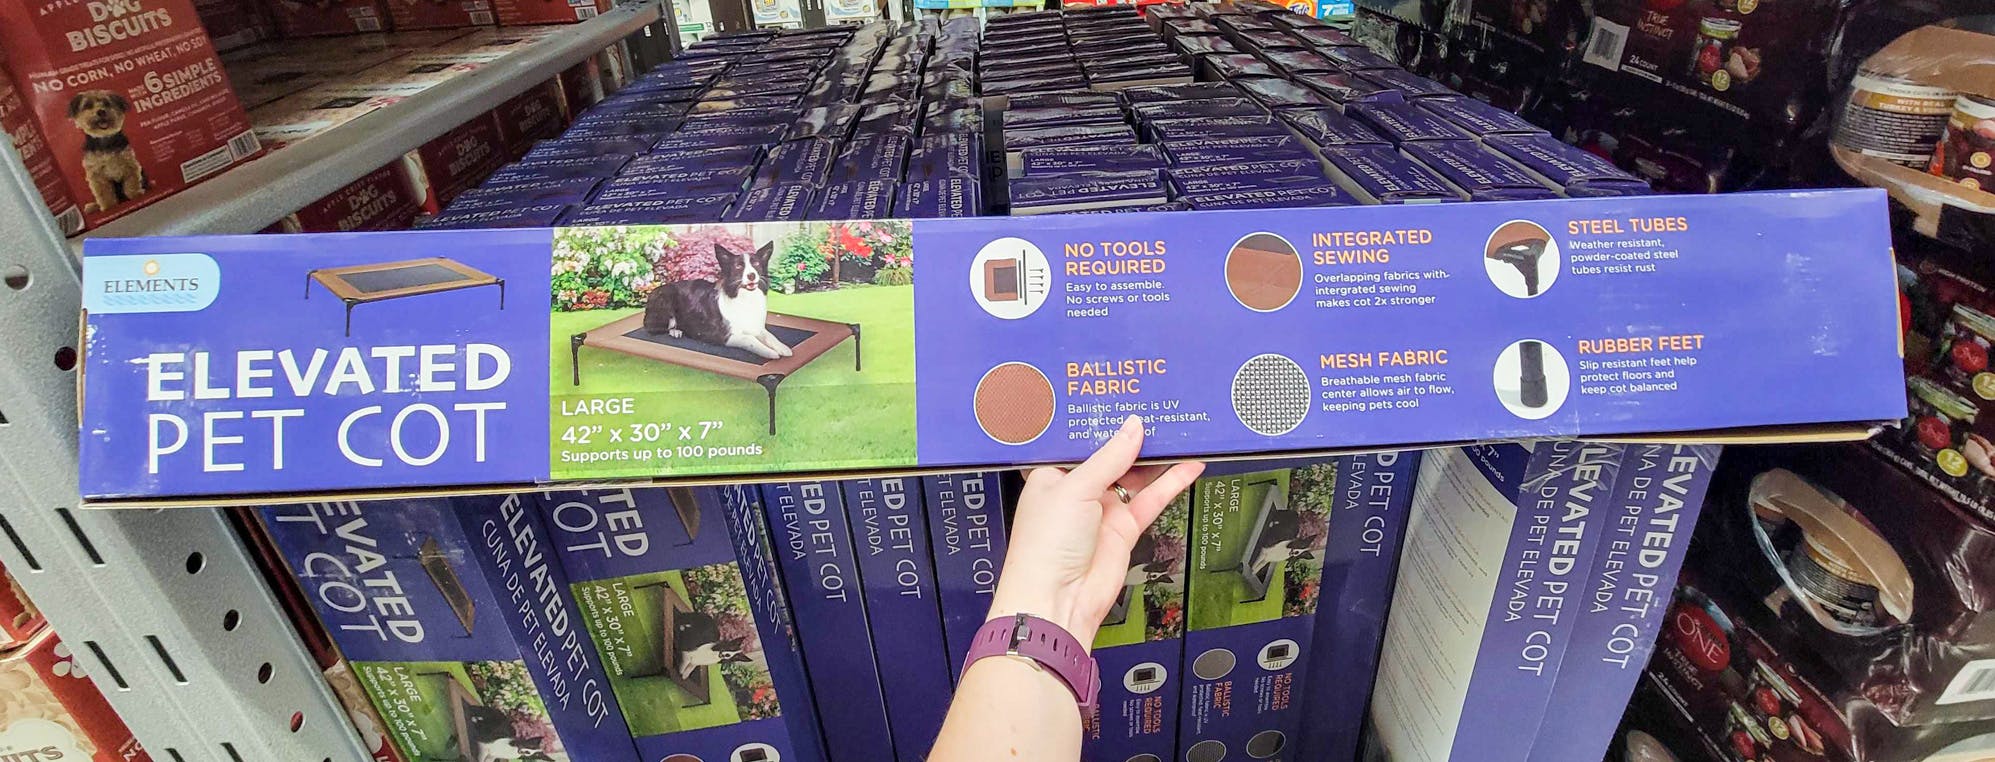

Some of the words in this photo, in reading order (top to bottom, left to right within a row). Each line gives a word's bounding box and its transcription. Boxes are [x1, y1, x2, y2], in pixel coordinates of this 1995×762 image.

[66, 8, 172, 52] BISCUITS
[32, 78, 64, 94] NO
[114, 59, 134, 73] NO
[175, 41, 191, 54] NO
[144, 71, 163, 93] 6
[162, 57, 216, 88] SIMPLE
[1630, 54, 1639, 65] 24
[133, 71, 221, 113] INGREDIENTS
[584, 200, 664, 211] ELEVATED
[1195, 191, 1276, 203] ELEVATED
[1312, 229, 1433, 247] INTEGRATED
[1568, 220, 1624, 234] STEEL
[1629, 217, 1688, 232] TUBES
[1065, 243, 1094, 258] NO
[1101, 241, 1166, 256] TOOLS
[1313, 249, 1390, 265] SEWING
[1569, 239, 1614, 250] Weather
[1617, 238, 1665, 248] resistant,
[1571, 252, 1651, 263] powder-coated
[1653, 250, 1679, 259] steel
[1066, 259, 1166, 277] REQUIRED
[1314, 272, 1381, 284] Overlapping
[1383, 271, 1420, 281] fabrics
[1423, 270, 1447, 279] with
[1572, 265, 1601, 275] tubes
[1604, 264, 1632, 273] resist
[1635, 263, 1656, 272] rust
[103, 277, 199, 294] ELEMENTS
[1066, 282, 1092, 293] Easy
[1095, 281, 1107, 291] to
[1110, 280, 1165, 290] assemble.
[1066, 295, 1083, 305] No
[1086, 295, 1124, 304] screws
[1127, 294, 1139, 302] or
[1142, 292, 1170, 302] tools
[1315, 285, 1376, 297] intergrated
[1379, 284, 1416, 294] sewing
[1067, 307, 1109, 317] needed
[1316, 298, 1351, 308] makes
[1353, 297, 1371, 306] cot
[1374, 296, 1388, 306] 2x
[1390, 295, 1436, 307] stronger
[1320, 353, 1372, 369] MESH
[1379, 350, 1449, 366] FABRIC
[1578, 338, 1653, 354] RUBBER
[1658, 335, 1704, 351] FEET
[147, 343, 511, 401] ELEVATED
[1067, 359, 1167, 378] BALLISTIC
[1321, 375, 1380, 386] Breathable
[1383, 374, 1412, 384] mesh
[1415, 372, 1446, 382] fabric
[1579, 360, 1599, 371] Slip
[1602, 358, 1646, 369] resistant
[1649, 357, 1671, 367] feet
[1674, 356, 1697, 367] help
[1580, 372, 1619, 383] protect
[1622, 370, 1652, 381] floors
[1655, 370, 1674, 379] and
[1067, 379, 1140, 396] FABRIC
[1322, 389, 1356, 399] center
[1360, 387, 1394, 397] allows
[1397, 387, 1411, 395] air
[1414, 386, 1426, 395] to
[1428, 384, 1455, 395] flow,
[1581, 385, 1606, 395] keep
[1609, 384, 1627, 393] cot
[1630, 382, 1677, 392] balanced
[561, 398, 635, 416] LARGE
[1068, 403, 1112, 414] Ballistic
[1115, 401, 1147, 412] fabric
[1151, 400, 1160, 410] is
[1163, 400, 1179, 410] UV
[1138, 412, 1210, 424] eat-resistant,
[1322, 401, 1366, 412] keeping
[1369, 401, 1393, 412] pets
[1396, 399, 1419, 409] cool
[148, 409, 305, 474] PET
[337, 402, 507, 467] COT
[609, 429, 622, 443] x
[678, 426, 691, 441] x
[1069, 429, 1090, 440] and
[1093, 426, 1156, 439] wateof
[561, 448, 630, 463] Supports
[633, 450, 652, 462] up
[656, 447, 673, 459] to
[676, 446, 703, 458] 100
[708, 443, 763, 459] pounds
[1229, 479, 1240, 513] LARGE
[1344, 454, 1367, 510] LEVADA
[1368, 472, 1395, 510] PET
[1536, 486, 1559, 509] DE
[1628, 476, 1652, 501] DE
[1548, 447, 1608, 576] LEVATED
[1617, 505, 1642, 537] PET
[1638, 446, 1698, 568] EVATED
[546, 492, 612, 558] OT
[779, 496, 807, 560] ELEVADA
[809, 519, 837, 557] PET
[859, 491, 884, 556] ELEVADA
[888, 514, 914, 553] PET
[940, 491, 961, 555] ELEVADA
[966, 514, 991, 552] PET
[1360, 516, 1385, 557] COT
[1527, 515, 1550, 546] PET
[321, 501, 424, 643] EVATED
[820, 563, 847, 603] COT
[896, 559, 921, 599] COT
[972, 558, 996, 596] COT
[1504, 550, 1540, 622] ELEVADA
[1590, 540, 1631, 613] ELEVADA
[304, 552, 388, 641] COT
[500, 494, 569, 637] ELEVATED
[561, 629, 590, 681] PET
[583, 678, 609, 728] COT
[612, 582, 635, 618] LARGE
[1534, 580, 1568, 625] PET
[1621, 572, 1659, 619] PET
[482, 519, 512, 577] CUNA
[506, 572, 525, 605] DE
[518, 599, 540, 636] PET
[533, 631, 571, 711] ELEVADA
[1518, 630, 1551, 677] COT
[1602, 623, 1639, 670] COT
[1677, 612, 1724, 664] ONE
[394, 666, 422, 702] LARGE
[1221, 680, 1232, 717] BALLISTIC
